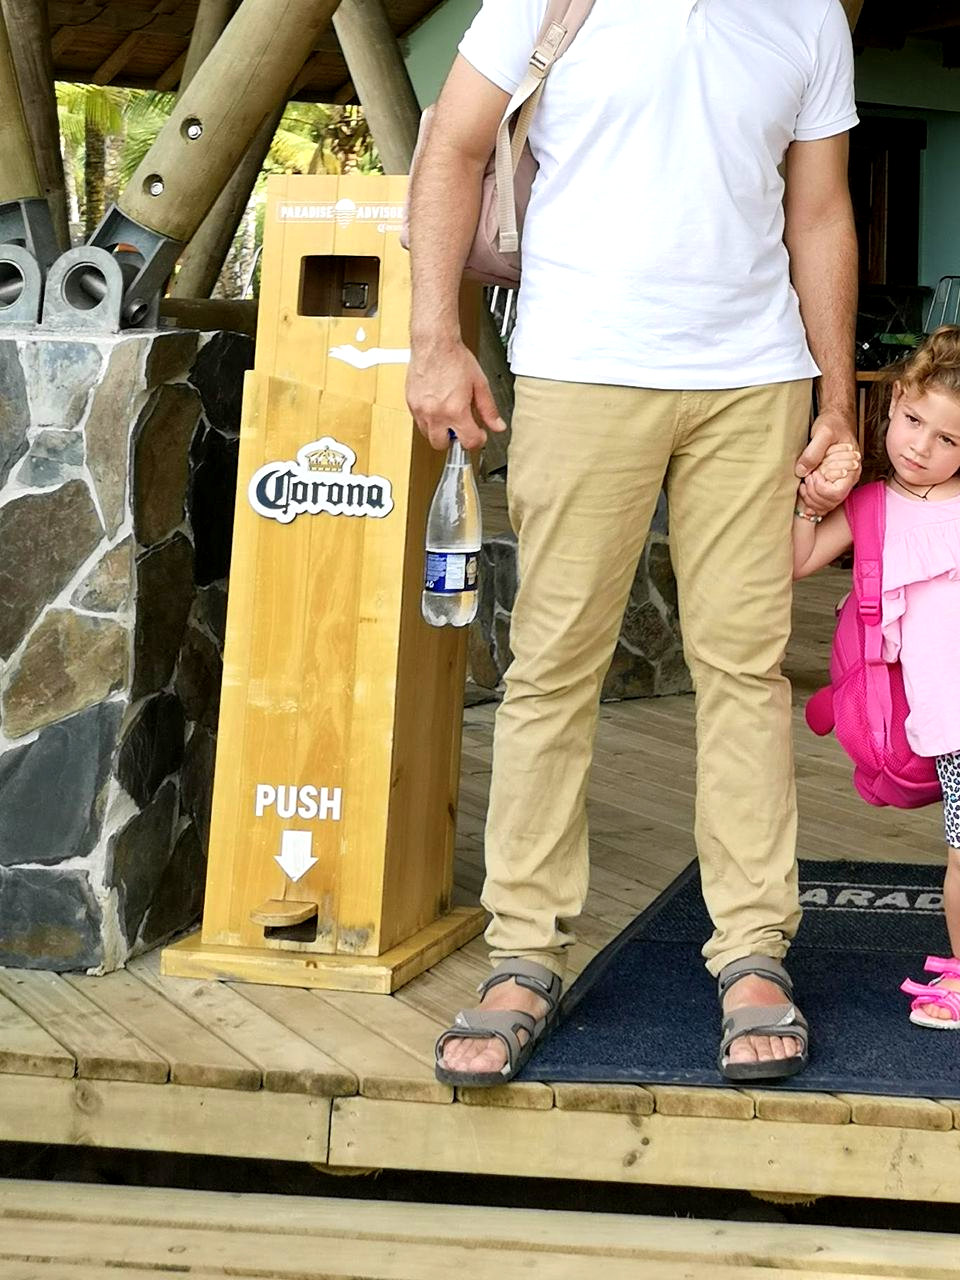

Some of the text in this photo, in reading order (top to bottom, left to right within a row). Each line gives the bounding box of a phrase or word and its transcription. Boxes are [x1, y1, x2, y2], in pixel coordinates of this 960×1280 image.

[280, 205, 336, 219] PARADISE
[255, 469, 386, 515] Corona
[255, 783, 342, 820] PUSH
